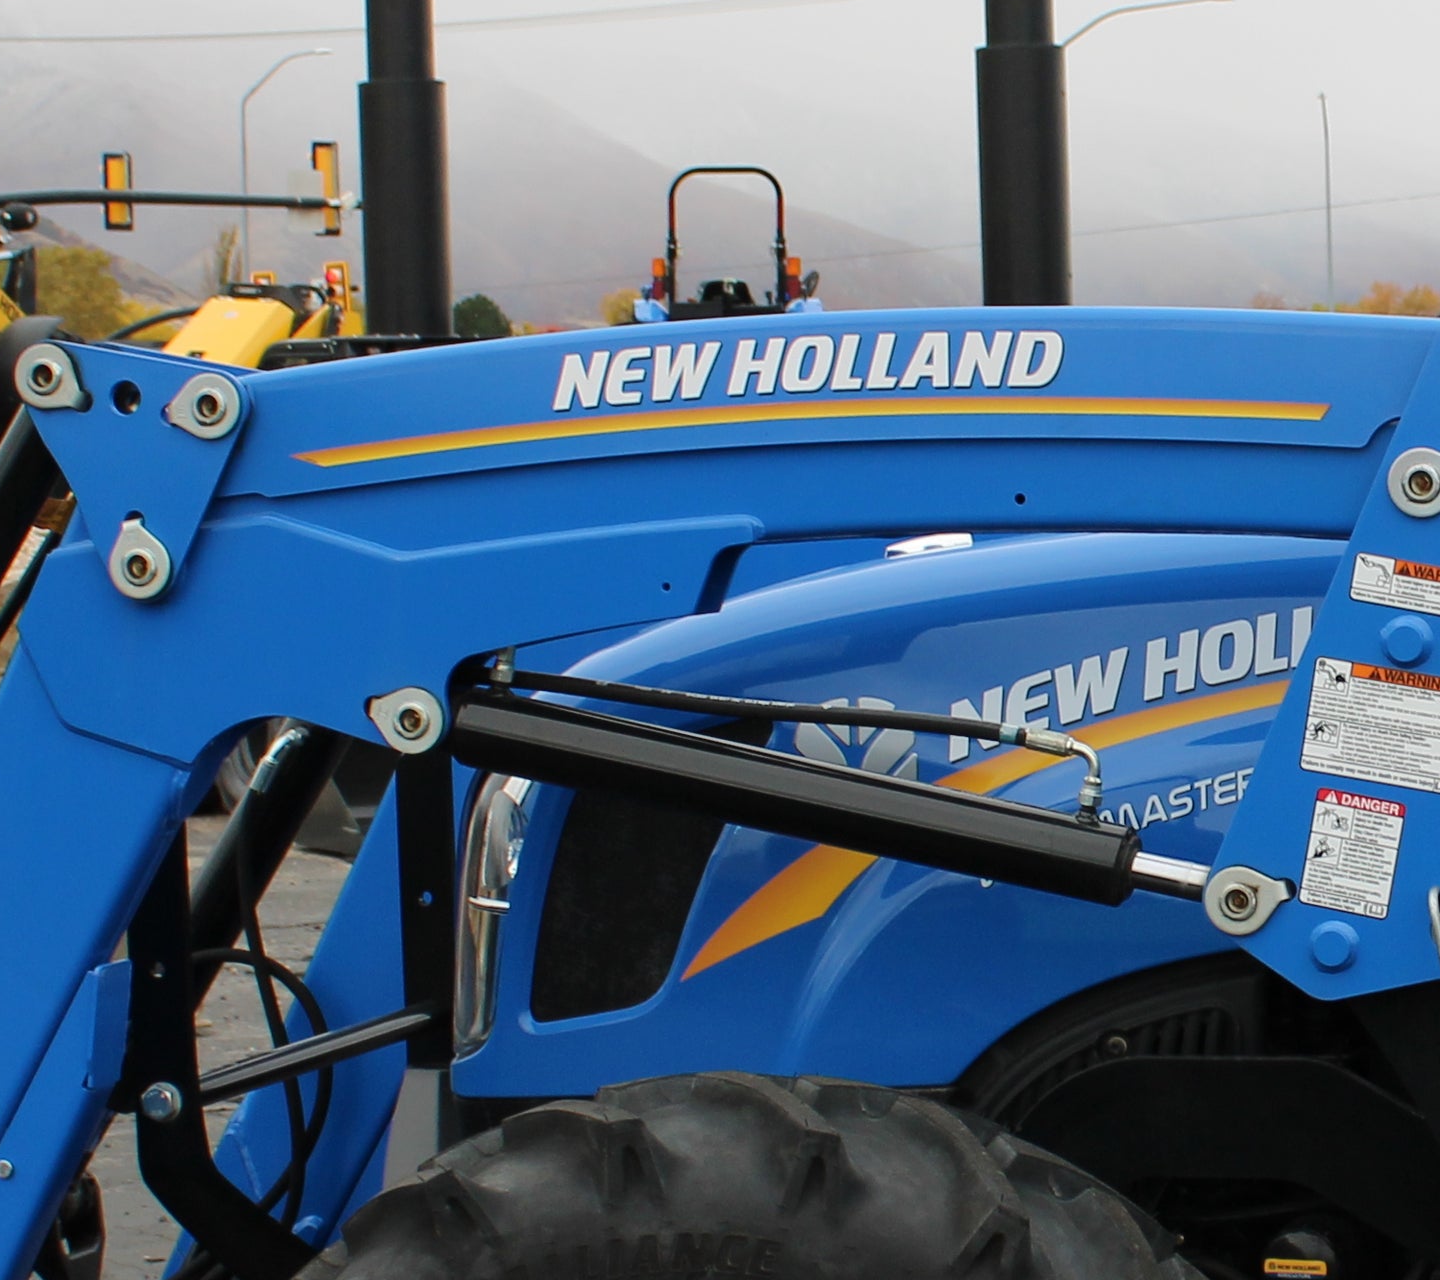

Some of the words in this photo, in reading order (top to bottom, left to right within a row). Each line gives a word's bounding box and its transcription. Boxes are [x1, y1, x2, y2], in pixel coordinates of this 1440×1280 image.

[553, 341, 722, 412] NEW
[727, 330, 1064, 397] HOLLAND
[949, 647, 1128, 763] NEW
[1341, 794, 1400, 816] DANGER
